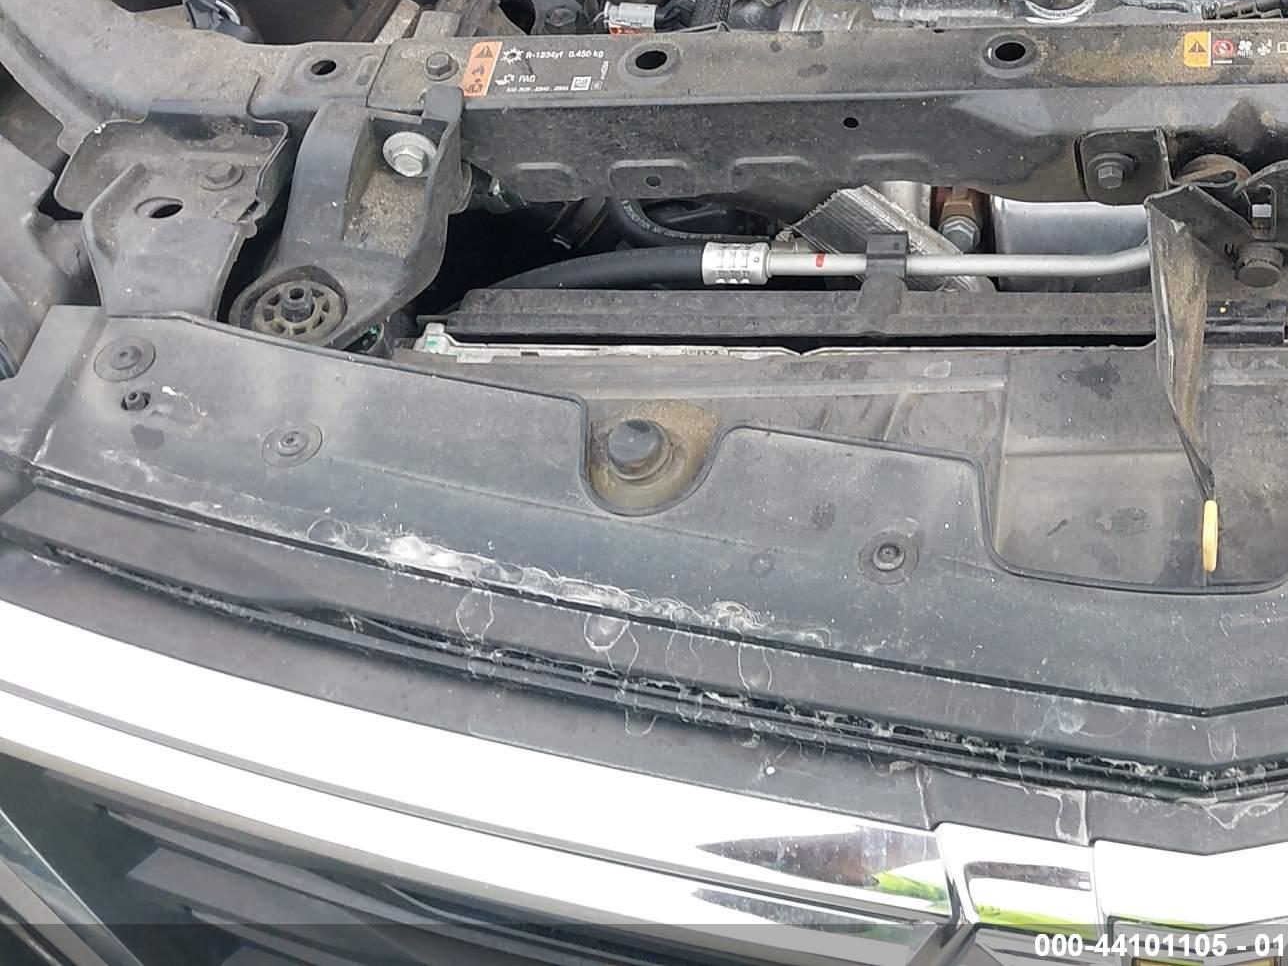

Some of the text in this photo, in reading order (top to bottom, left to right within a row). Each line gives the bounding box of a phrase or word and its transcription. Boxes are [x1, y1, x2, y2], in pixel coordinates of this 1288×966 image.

[525, 50, 604, 60] R-1234yf 0.450 kg
